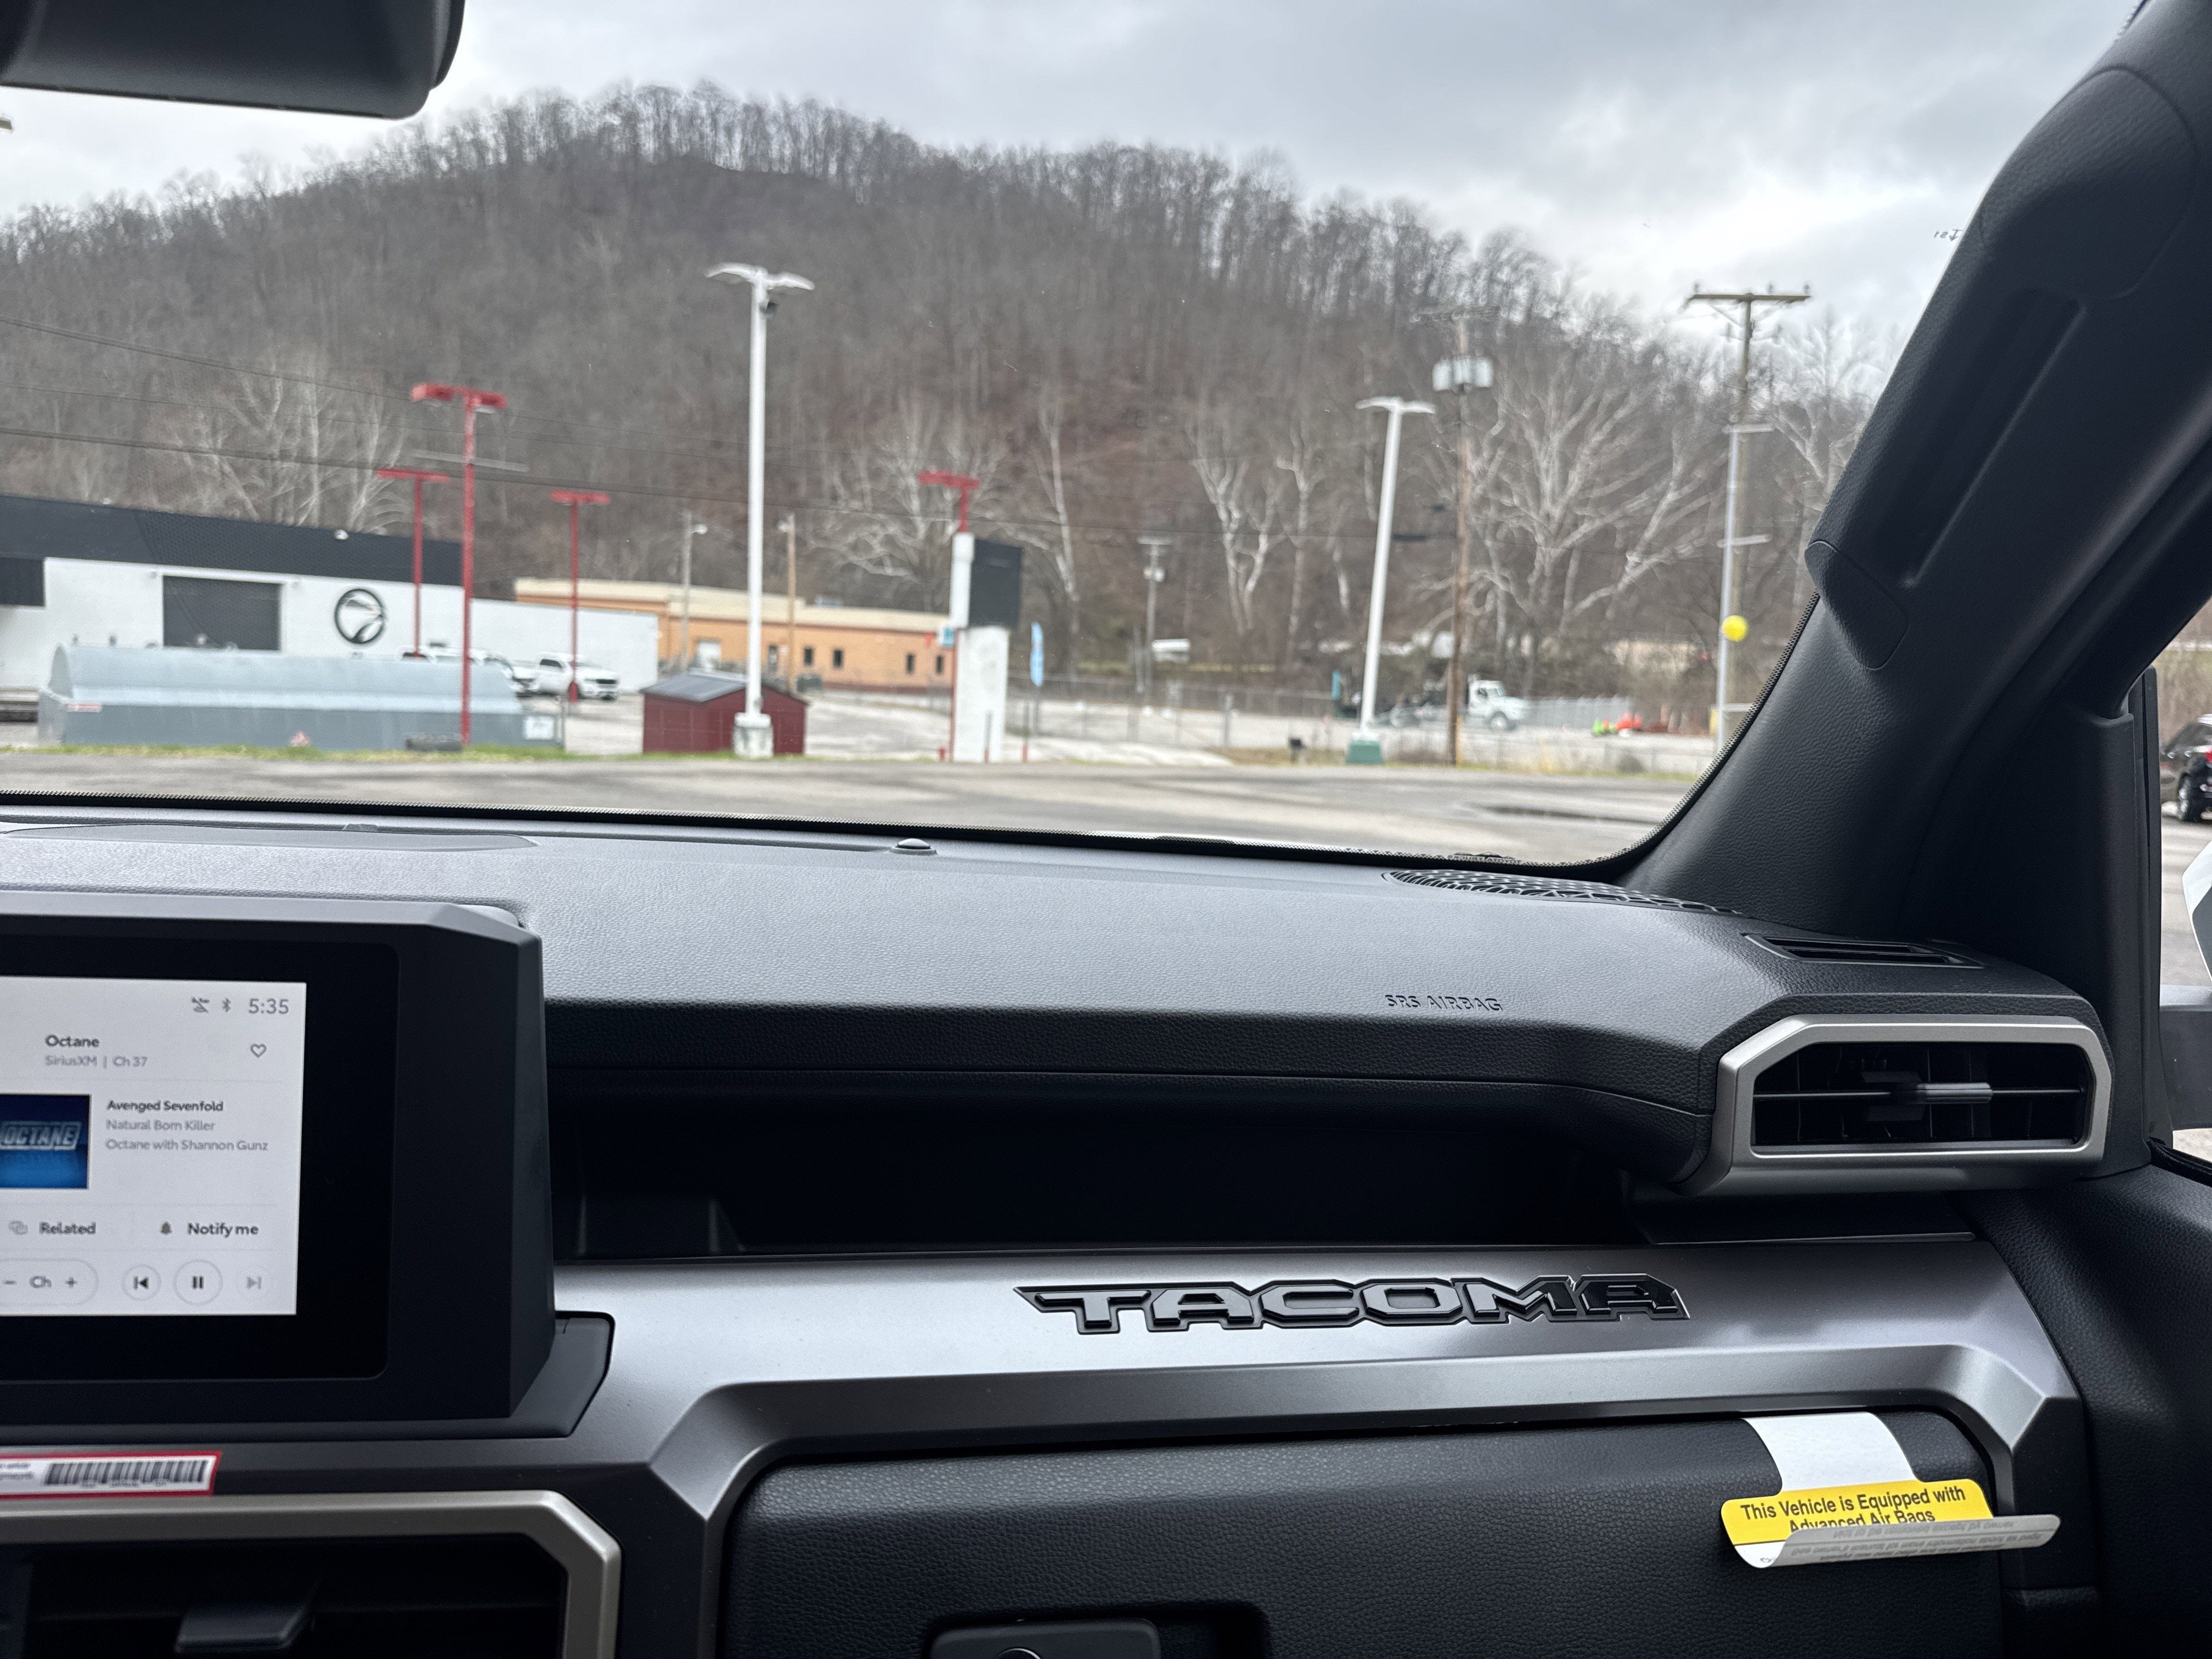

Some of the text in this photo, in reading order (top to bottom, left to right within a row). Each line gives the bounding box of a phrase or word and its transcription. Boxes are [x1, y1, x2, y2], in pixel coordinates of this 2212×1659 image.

[249, 998, 290, 1015] 5:35
[1384, 994, 1504, 1011] SRS AIRBAG
[44, 1034, 100, 1048] Octane
[44, 1054, 98, 1067] SiriusXM
[112, 1055, 131, 1067] Ch
[133, 1056, 148, 1067] 37
[106, 1099, 224, 1113] Avenged Sevenfold
[105, 1119, 151, 1131] Natural
[184, 1120, 216, 1131] Killer
[105, 1138, 269, 1151] Octane with Shannon Gunz
[39, 1222, 97, 1235] Related
[188, 1222, 259, 1238] Notify me
[29, 1276, 52, 1289] Ch
[1013, 1274, 1690, 1335] TACOMA
[1740, 1485, 1967, 1521] This Vehicle is Equipped with
[1870, 1511, 1891, 1526] Air
